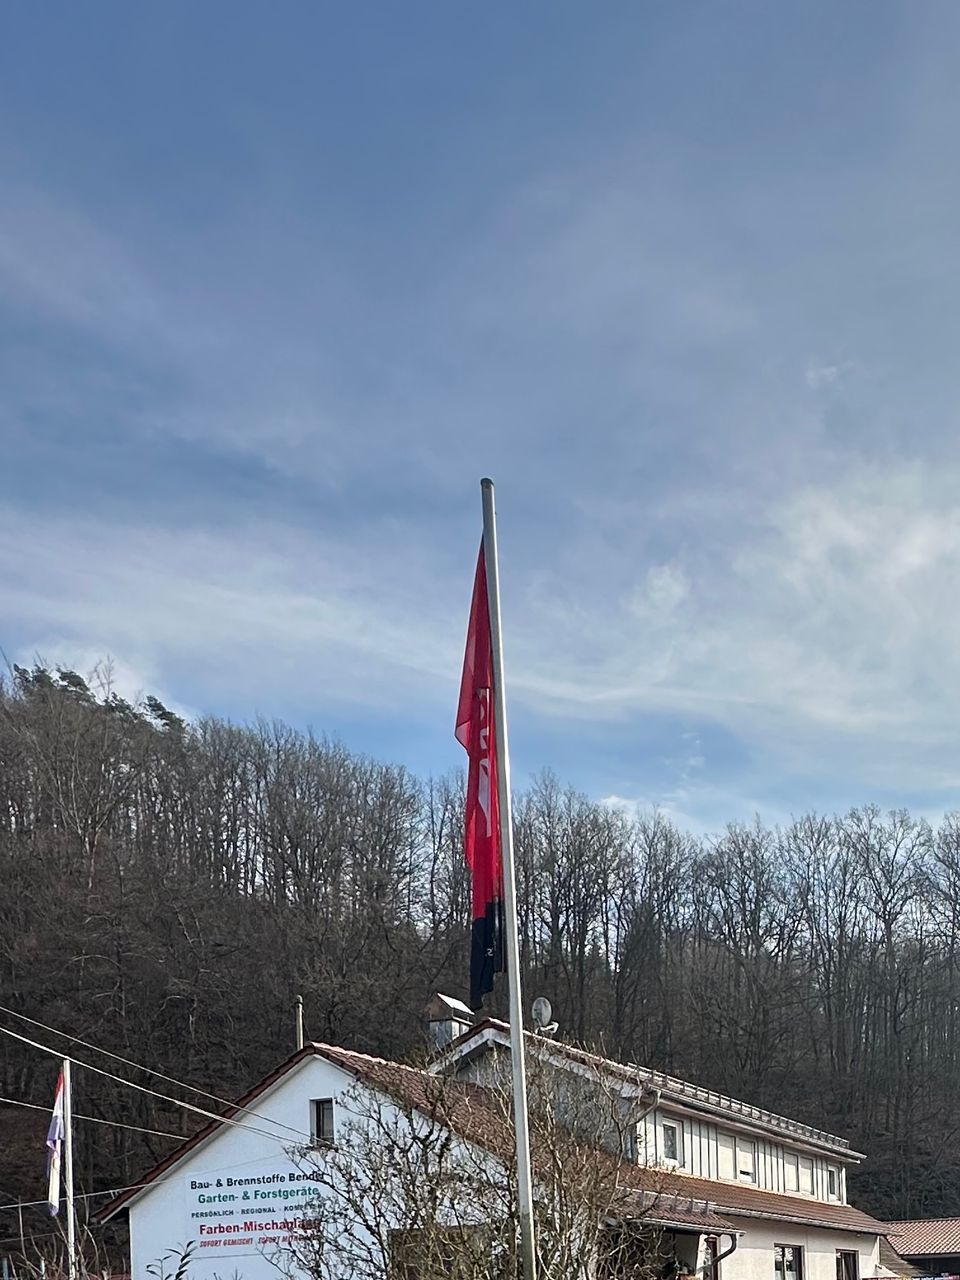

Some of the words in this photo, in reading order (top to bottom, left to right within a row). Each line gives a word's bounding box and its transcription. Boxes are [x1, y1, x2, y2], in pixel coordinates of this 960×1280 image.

[190, 1180, 213, 1190] Bau-
[215, 1178, 223, 1188] &
[226, 1173, 285, 1187] Brennstoffe
[198, 1193, 239, 1204] Garten-
[241, 1190, 250, 1201] &
[254, 1186, 320, 1200] Forstgeräte
